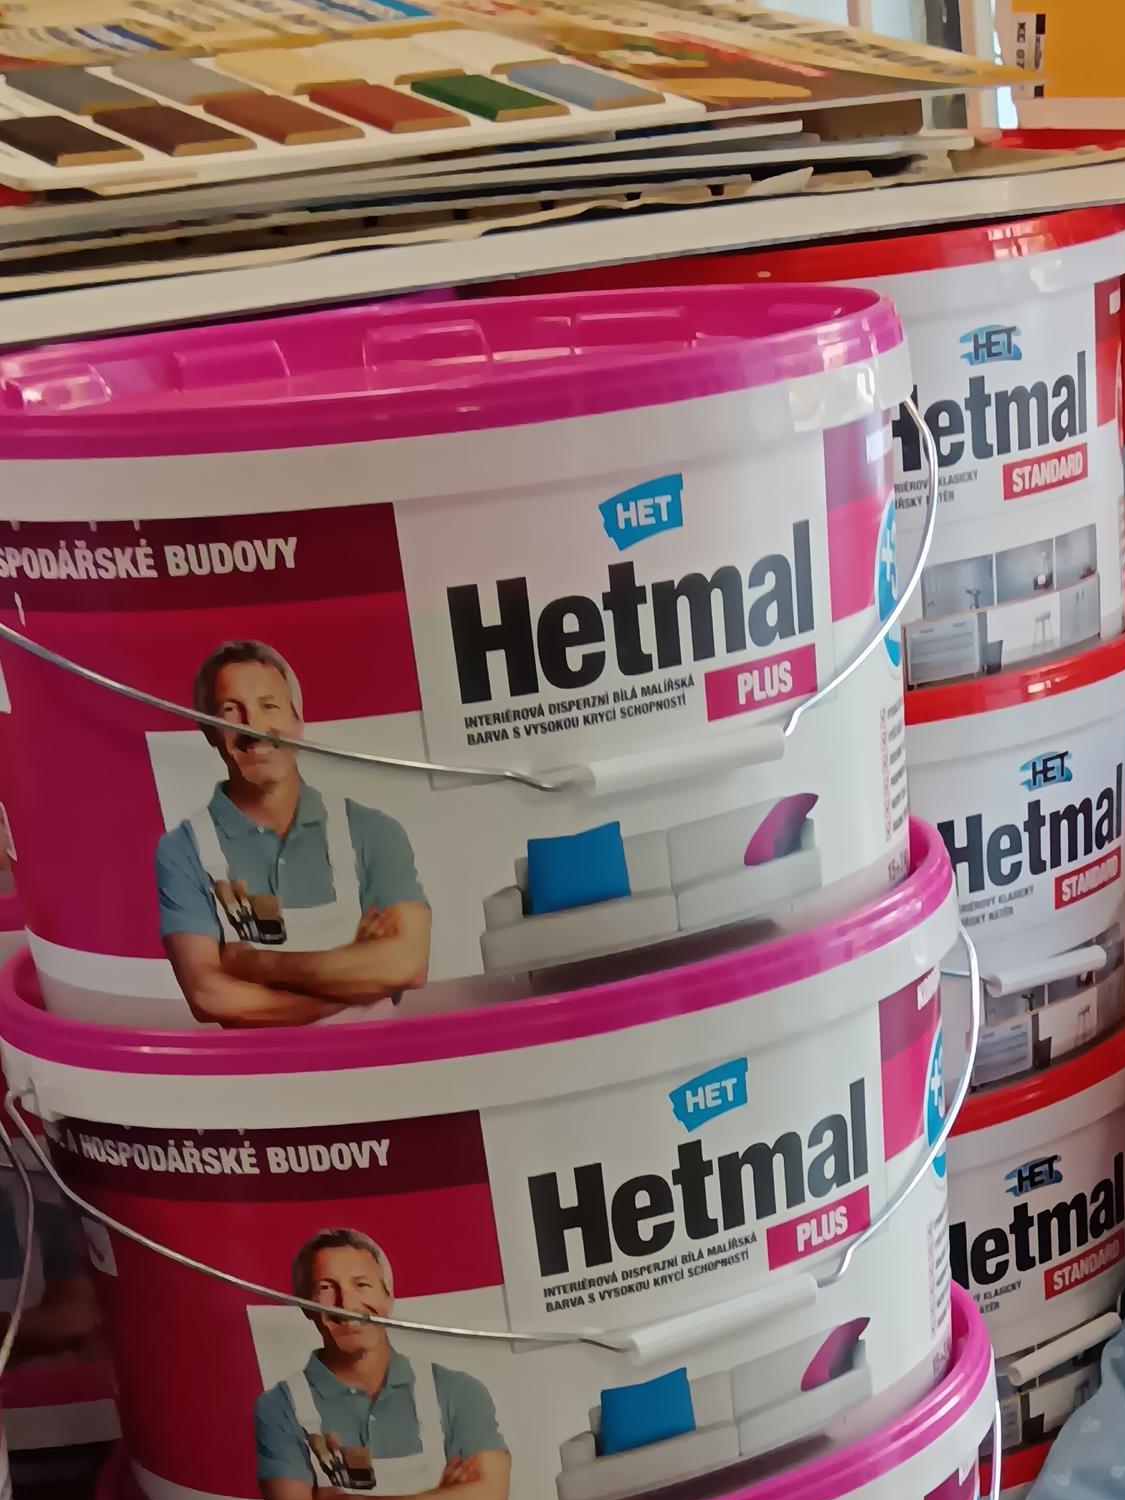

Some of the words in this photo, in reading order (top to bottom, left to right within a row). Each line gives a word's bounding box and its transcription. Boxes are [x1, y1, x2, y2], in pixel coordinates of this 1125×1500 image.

[973, 326, 1016, 360] HET
[1012, 452, 1083, 493] STANDARD
[618, 497, 671, 528] HET
[164, 537, 297, 577] BUDOVY
[447, 519, 815, 704] Hetmal
[738, 662, 792, 704] PLUS
[467, 726, 509, 745] BARVA
[513, 723, 521, 739] S
[525, 716, 579, 737] VYSOKOU
[583, 708, 616, 727] KRYCÍ
[620, 693, 686, 718] SCHOPNOSTÍ
[1032, 751, 1069, 785] HET
[937, 763, 1122, 897] Hetmal
[686, 1077, 737, 1114] HET
[81, 1132, 260, 1174] HOSPODÁŘSKÉ
[267, 1139, 391, 1174] BUDOVY
[1018, 1154, 1058, 1192] HET
[528, 1077, 869, 1277] Hetmal
[797, 1206, 848, 1251] PLUS
[546, 1295, 585, 1312] BARVA
[588, 1292, 596, 1303] S
[599, 1281, 650, 1301] VYSOKOU
